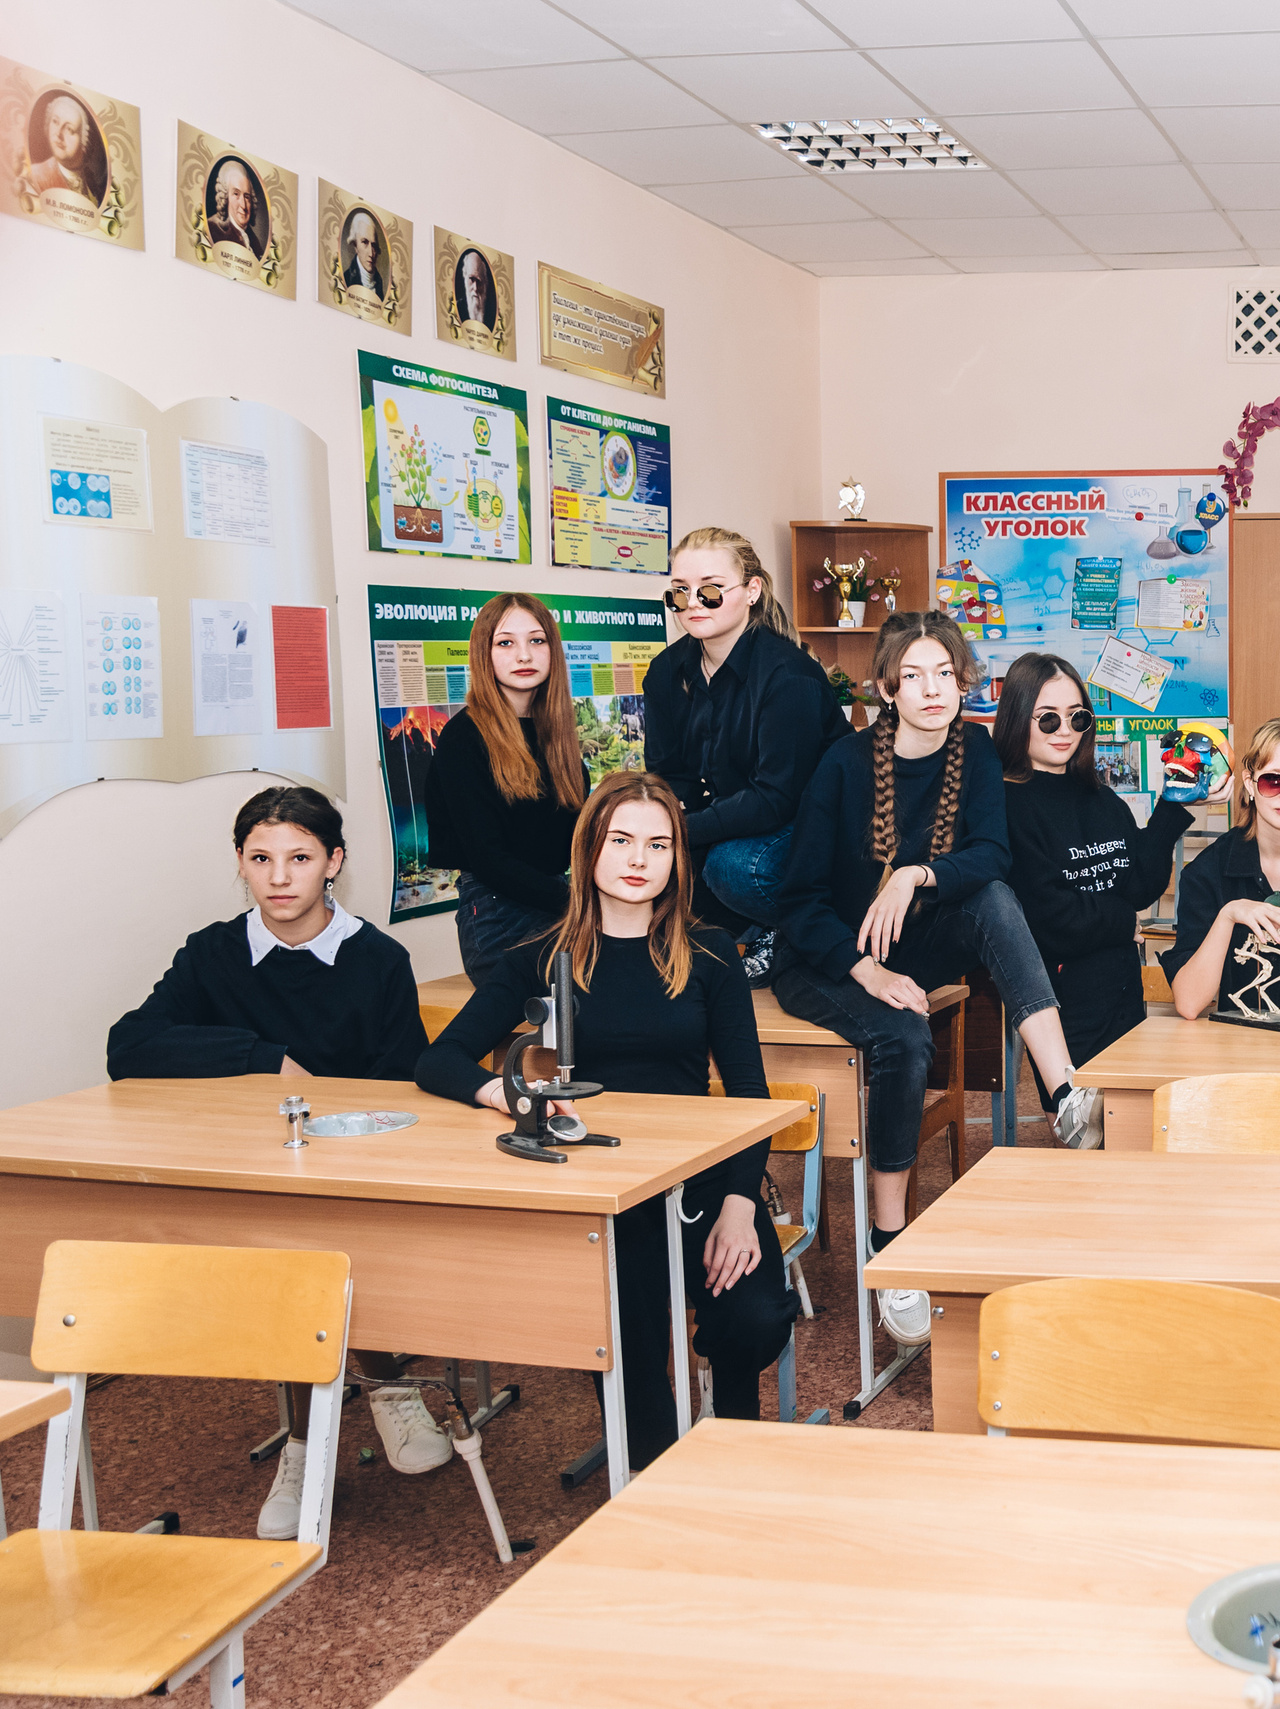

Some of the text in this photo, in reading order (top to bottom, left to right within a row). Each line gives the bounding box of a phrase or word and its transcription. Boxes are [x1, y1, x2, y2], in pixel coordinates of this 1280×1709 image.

[46, 198, 94, 218] М.В. ЛОМОНОСОВ
[392, 364, 499, 400] СХЕМА ФОТОСИНТЕЗА
[560, 405, 657, 437] ОТ КЛЕТКИ ДО ОРГАНИЗМА
[965, 490, 1105, 511] КЛАССНЫЙ
[1206, 499, 1216, 513] 9
[984, 519, 1087, 537] УГОЛОК
[374, 603, 457, 624] ЭВОЛЮЦИЯ
[563, 610, 572, 623] И
[574, 610, 635, 625] ЖИВОТНОГО
[637, 613, 664, 627] МИРА
[1129, 719, 1174, 730] УГОЛОК
[1090, 861, 1112, 877] you
[1096, 880, 1105, 892] it
